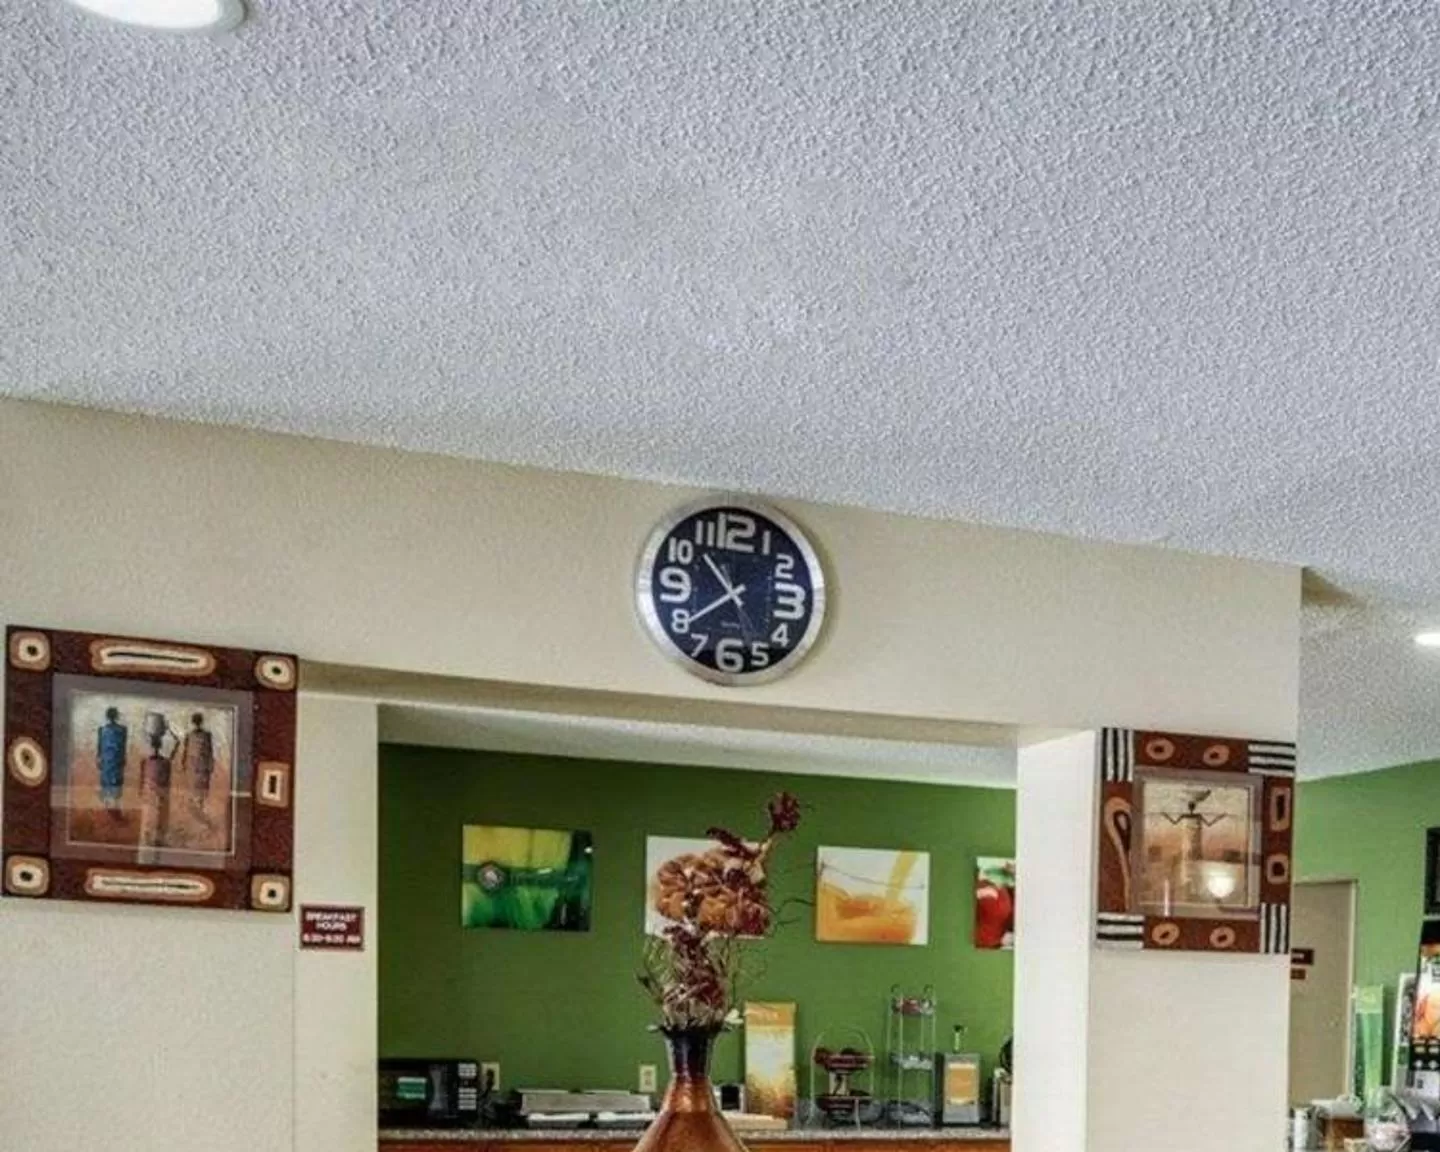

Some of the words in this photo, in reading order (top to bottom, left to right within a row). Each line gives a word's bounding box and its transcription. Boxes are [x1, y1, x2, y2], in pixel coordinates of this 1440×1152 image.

[695, 520, 715, 547] 11
[717, 513, 756, 553] 12
[762, 530, 772, 555] 1
[668, 537, 694, 565] 10
[775, 554, 795, 579] 2
[659, 567, 692, 604] 9
[772, 581, 806, 620] 3
[671, 608, 690, 634] 8
[690, 633, 709, 658] 7
[771, 622, 790, 648] 4
[715, 638, 744, 673] 6
[751, 641, 769, 667] 5
[316, 921, 347, 931] HOURS
